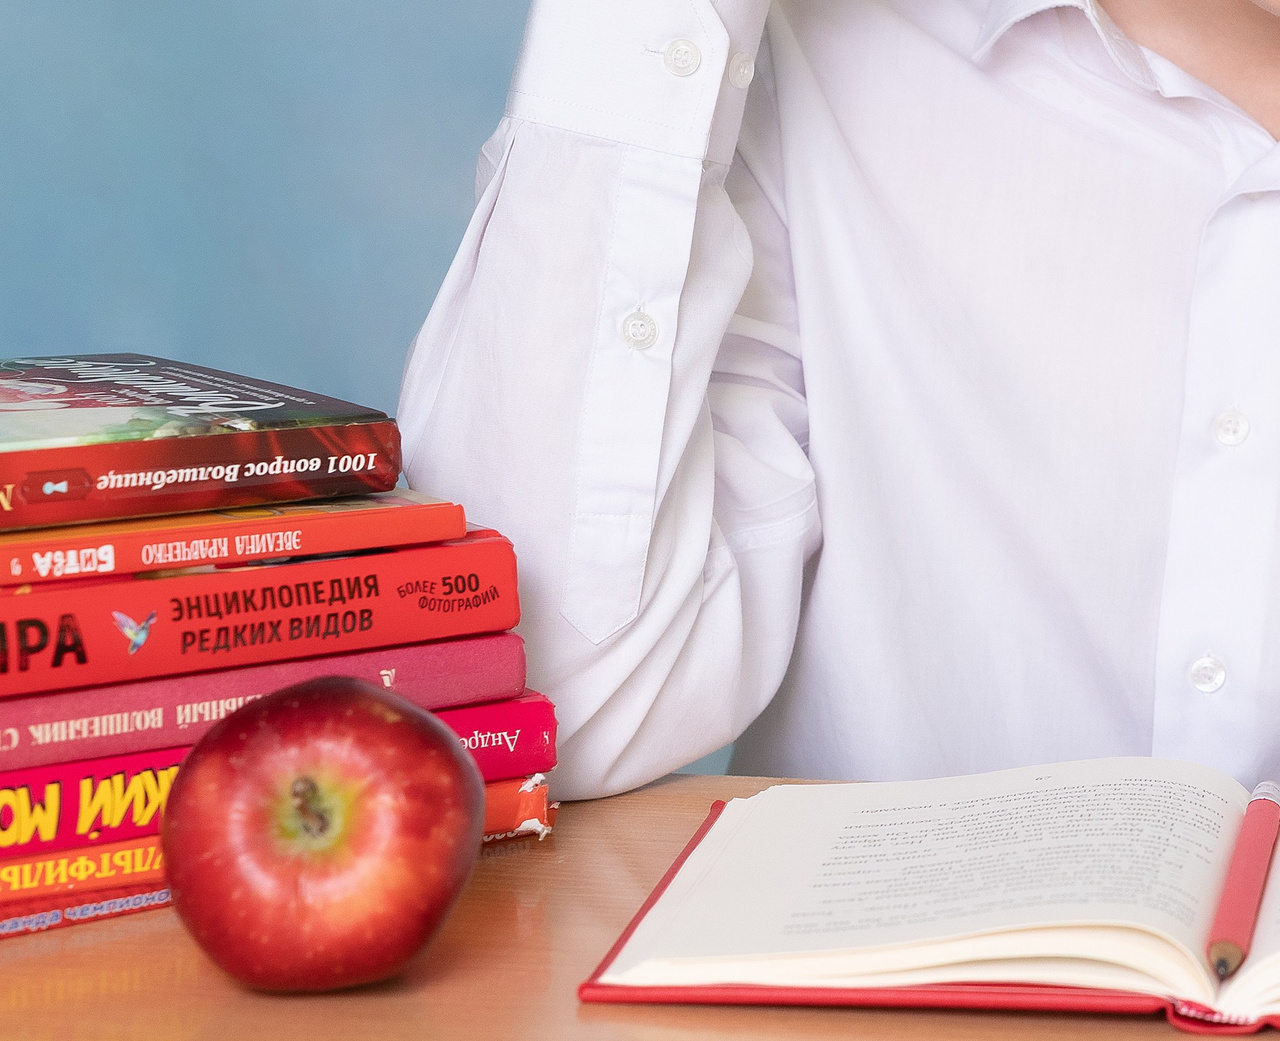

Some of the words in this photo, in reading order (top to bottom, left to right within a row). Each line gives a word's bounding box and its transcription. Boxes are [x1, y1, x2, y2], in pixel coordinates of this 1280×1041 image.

[96, 464, 241, 490] Волшебнице
[244, 456, 321, 478] вопрос
[327, 453, 377, 474] 1001
[142, 537, 228, 565] КРАВЧЕНКО
[235, 530, 302, 556] ЭВЕЛИНА
[170, 574, 379, 622] ЭНЦИКЛОПЕДИЯ
[396, 580, 438, 599] БОЛЕЕ
[441, 573, 480, 596] 500
[417, 585, 500, 613] ФОТОГРАФИЙ
[180, 619, 281, 655] РЕДКИХ
[289, 608, 373, 640] ВИДОВ
[28, 707, 164, 745] ВОЛШЕБНИК
